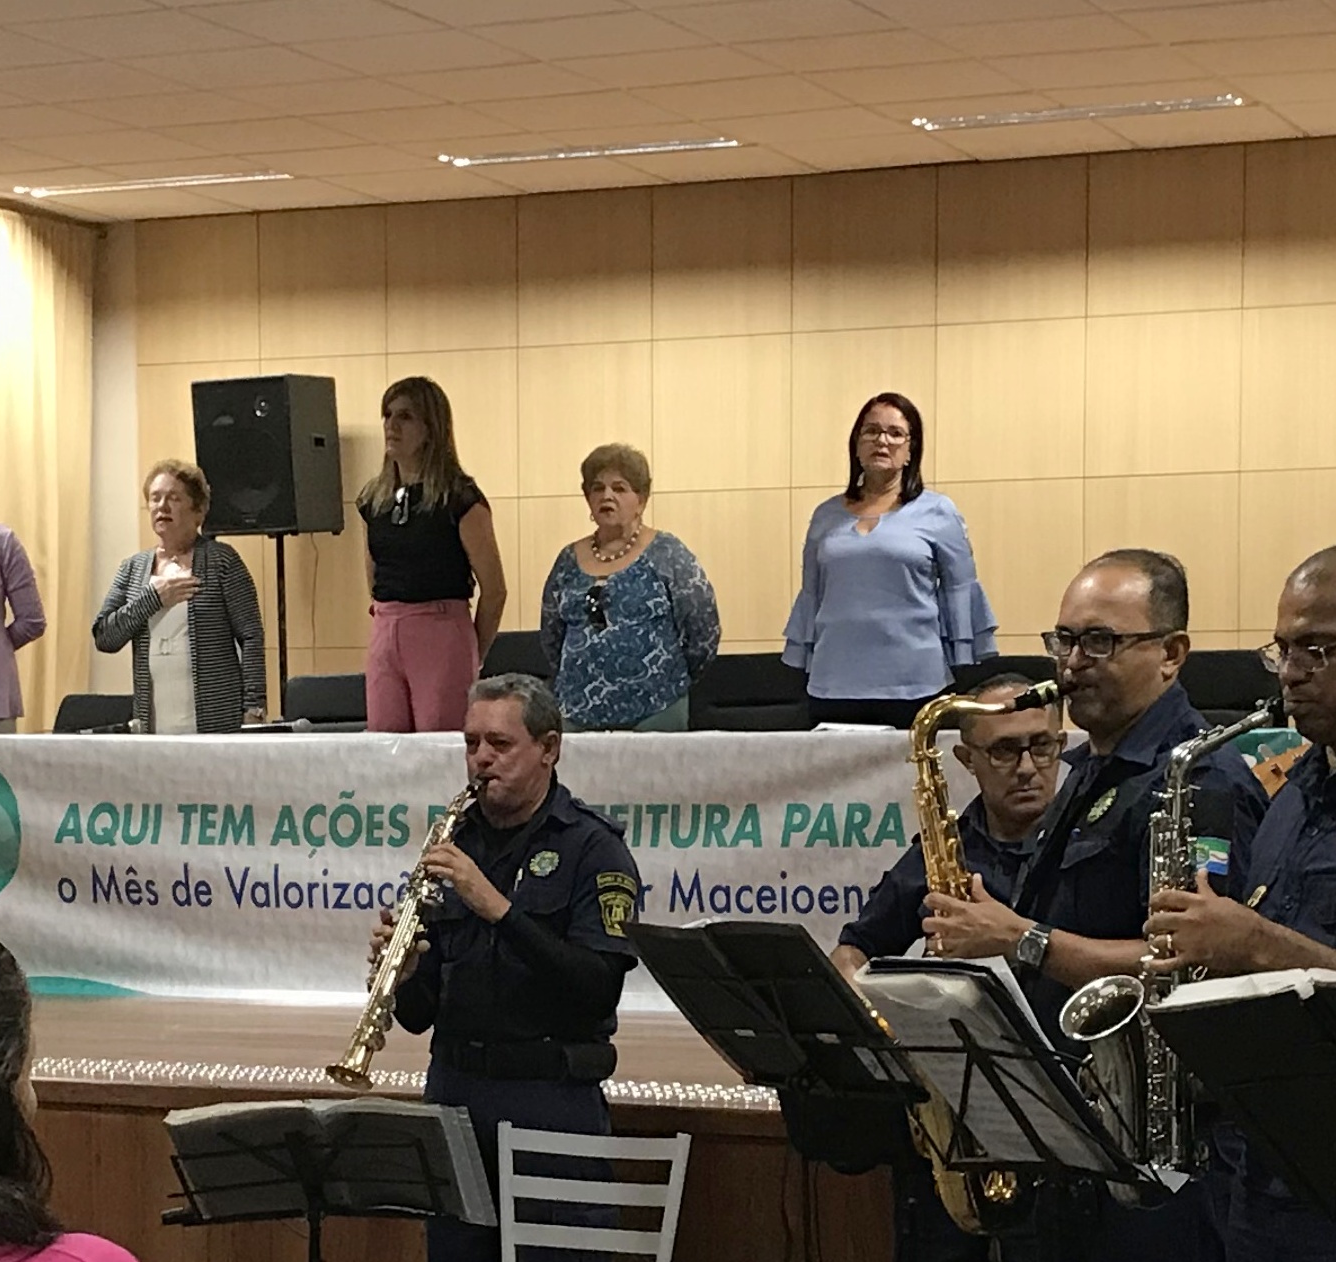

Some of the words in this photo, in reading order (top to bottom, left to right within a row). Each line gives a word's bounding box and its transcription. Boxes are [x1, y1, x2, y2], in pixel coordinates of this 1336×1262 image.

[54, 802, 163, 846] AQUI
[177, 803, 255, 846] TEM
[270, 790, 410, 859] AÇÕES
[780, 802, 906, 848] PARA
[58, 877, 77, 902] o
[91, 863, 159, 906] Mês
[172, 863, 213, 907] de
[669, 868, 877, 914] Maceioen
